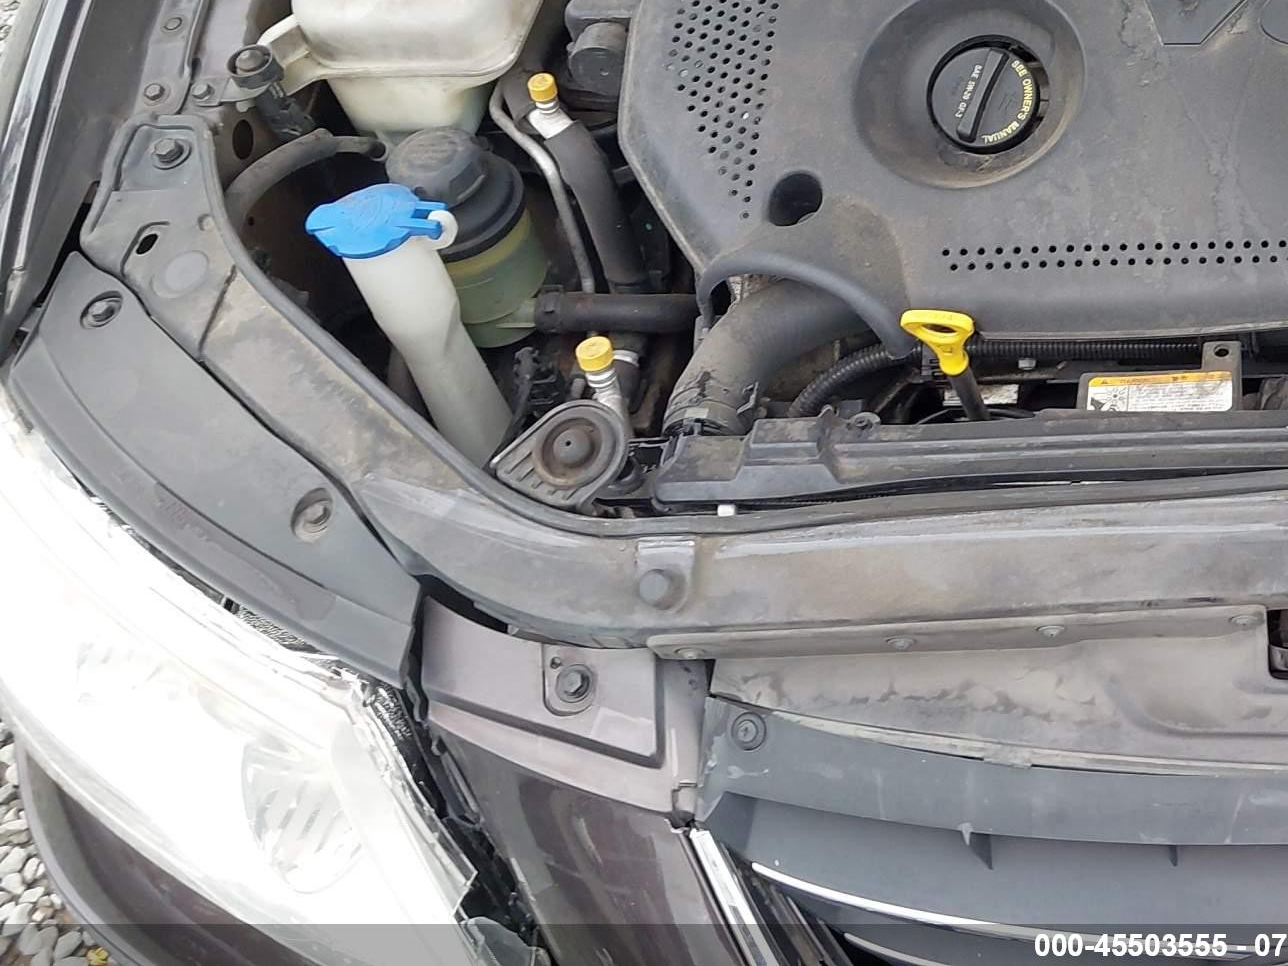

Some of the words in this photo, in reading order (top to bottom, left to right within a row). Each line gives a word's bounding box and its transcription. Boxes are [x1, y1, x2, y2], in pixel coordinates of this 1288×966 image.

[1011, 60, 1028, 77] SEE
[1017, 78, 1033, 120] OWNER'S
[981, 120, 1020, 145] MANUAL
